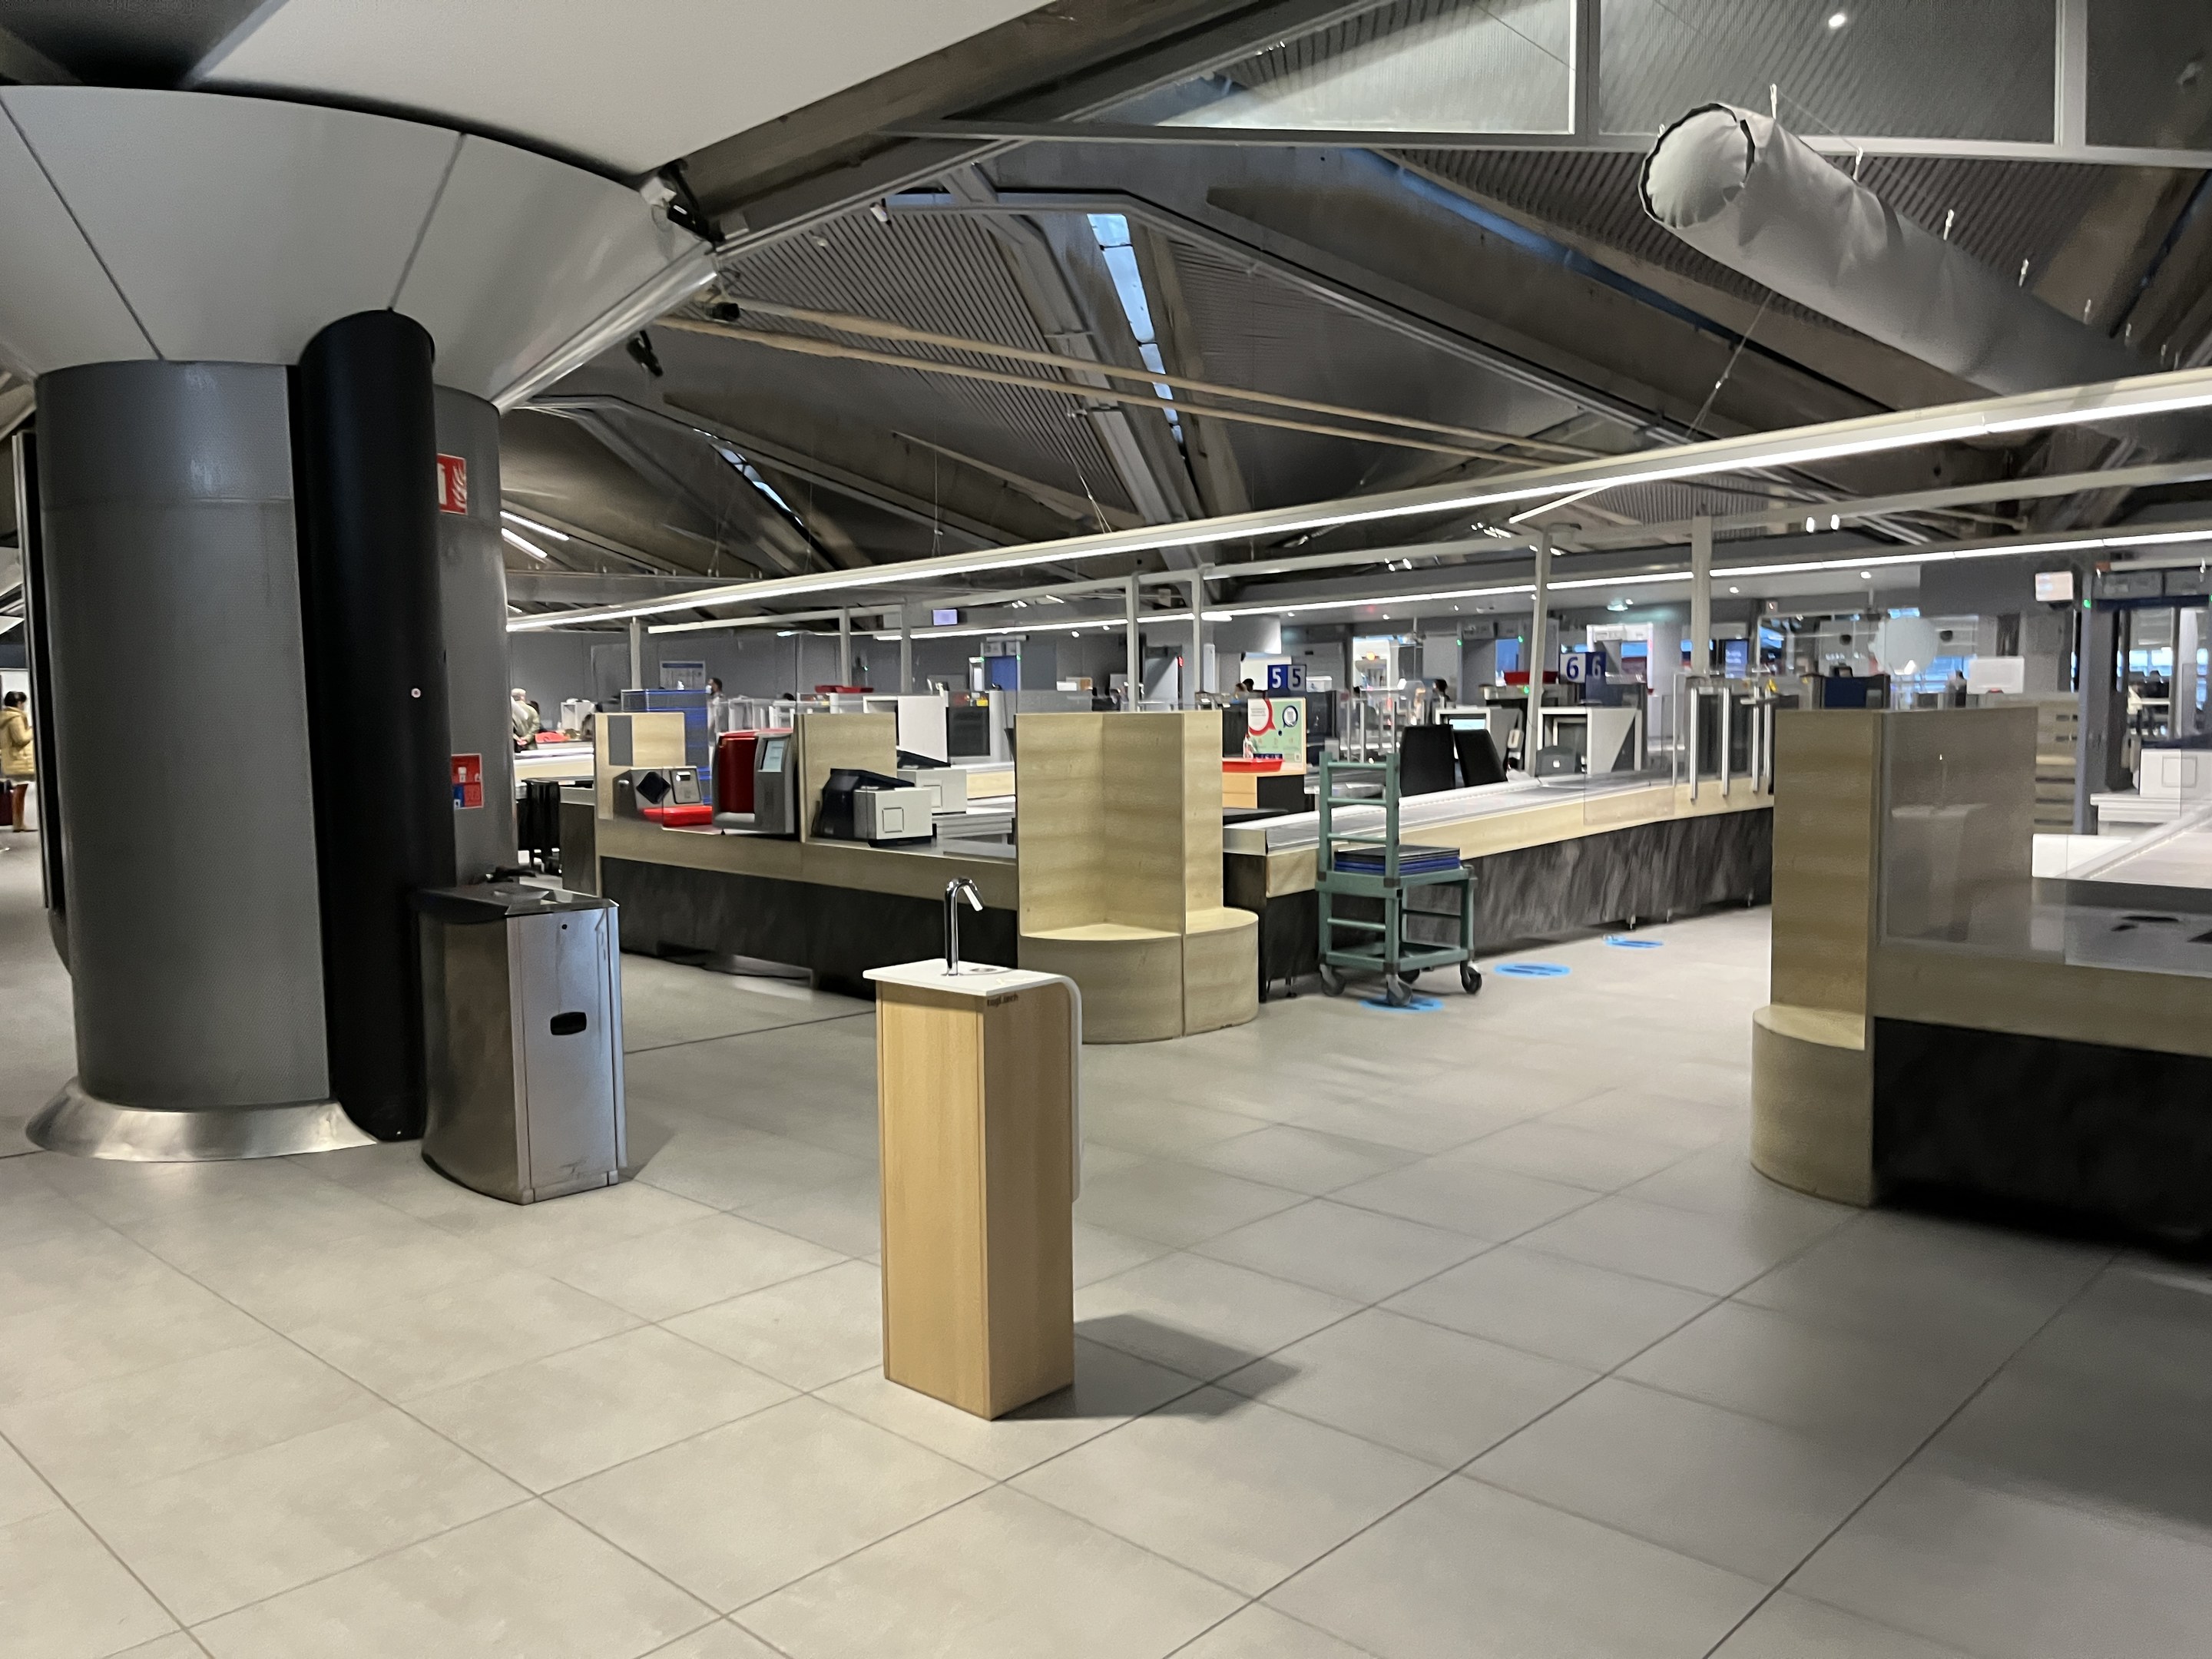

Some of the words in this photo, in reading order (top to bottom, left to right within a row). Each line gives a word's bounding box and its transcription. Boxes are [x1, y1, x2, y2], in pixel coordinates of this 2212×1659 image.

[1272, 667, 1281, 689] 5
[1293, 667, 1301, 688] 5
[1566, 656, 1579, 680] 6
[1591, 654, 1601, 680] 6
